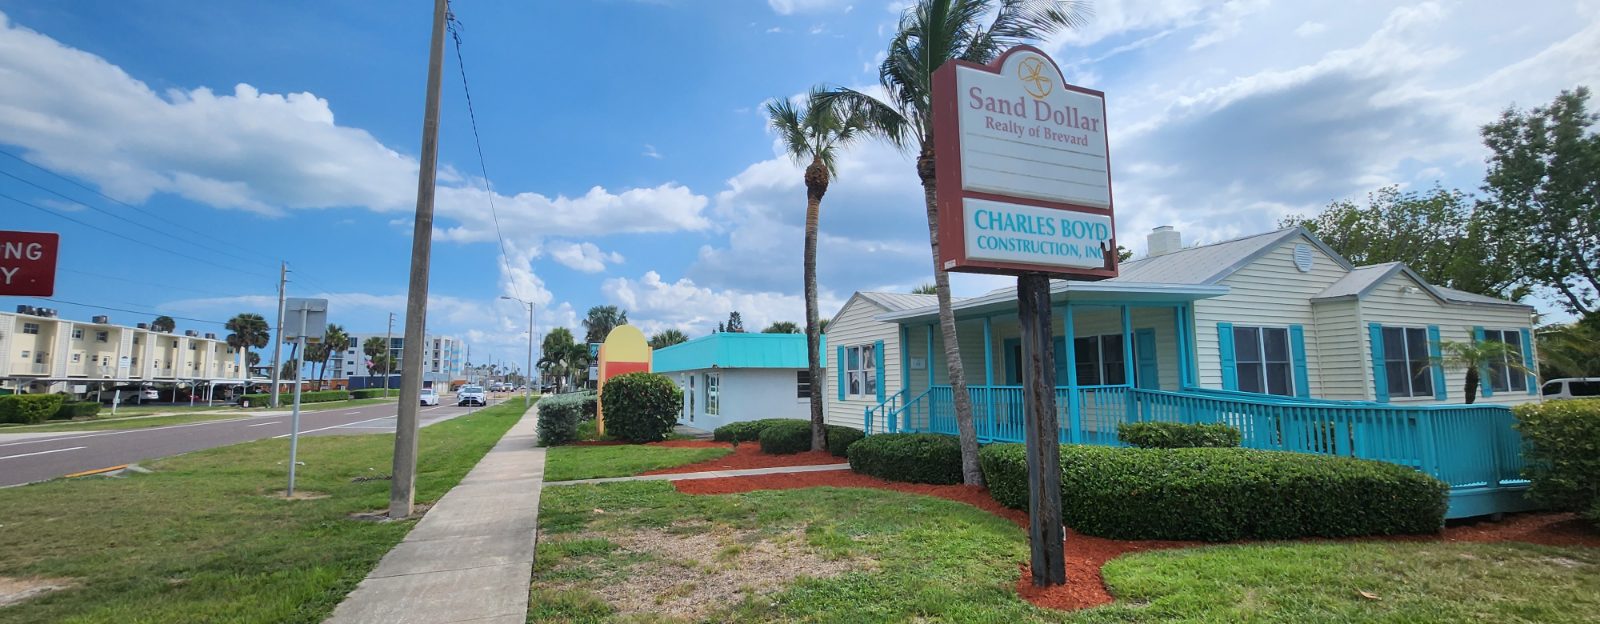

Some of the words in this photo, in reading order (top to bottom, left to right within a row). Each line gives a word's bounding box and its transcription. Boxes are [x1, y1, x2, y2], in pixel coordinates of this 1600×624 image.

[969, 86, 1026, 118] Sand
[1034, 99, 1099, 132] Dollar
[985, 116, 1025, 138] Realty
[1029, 126, 1040, 137] of
[1043, 127, 1088, 147] Brevard
[974, 209, 1056, 236] CHARLES
[1061, 219, 1108, 241] BOYD
[0, 241, 43, 260] NG
[977, 235, 1082, 259] CONSTRUCTION,
